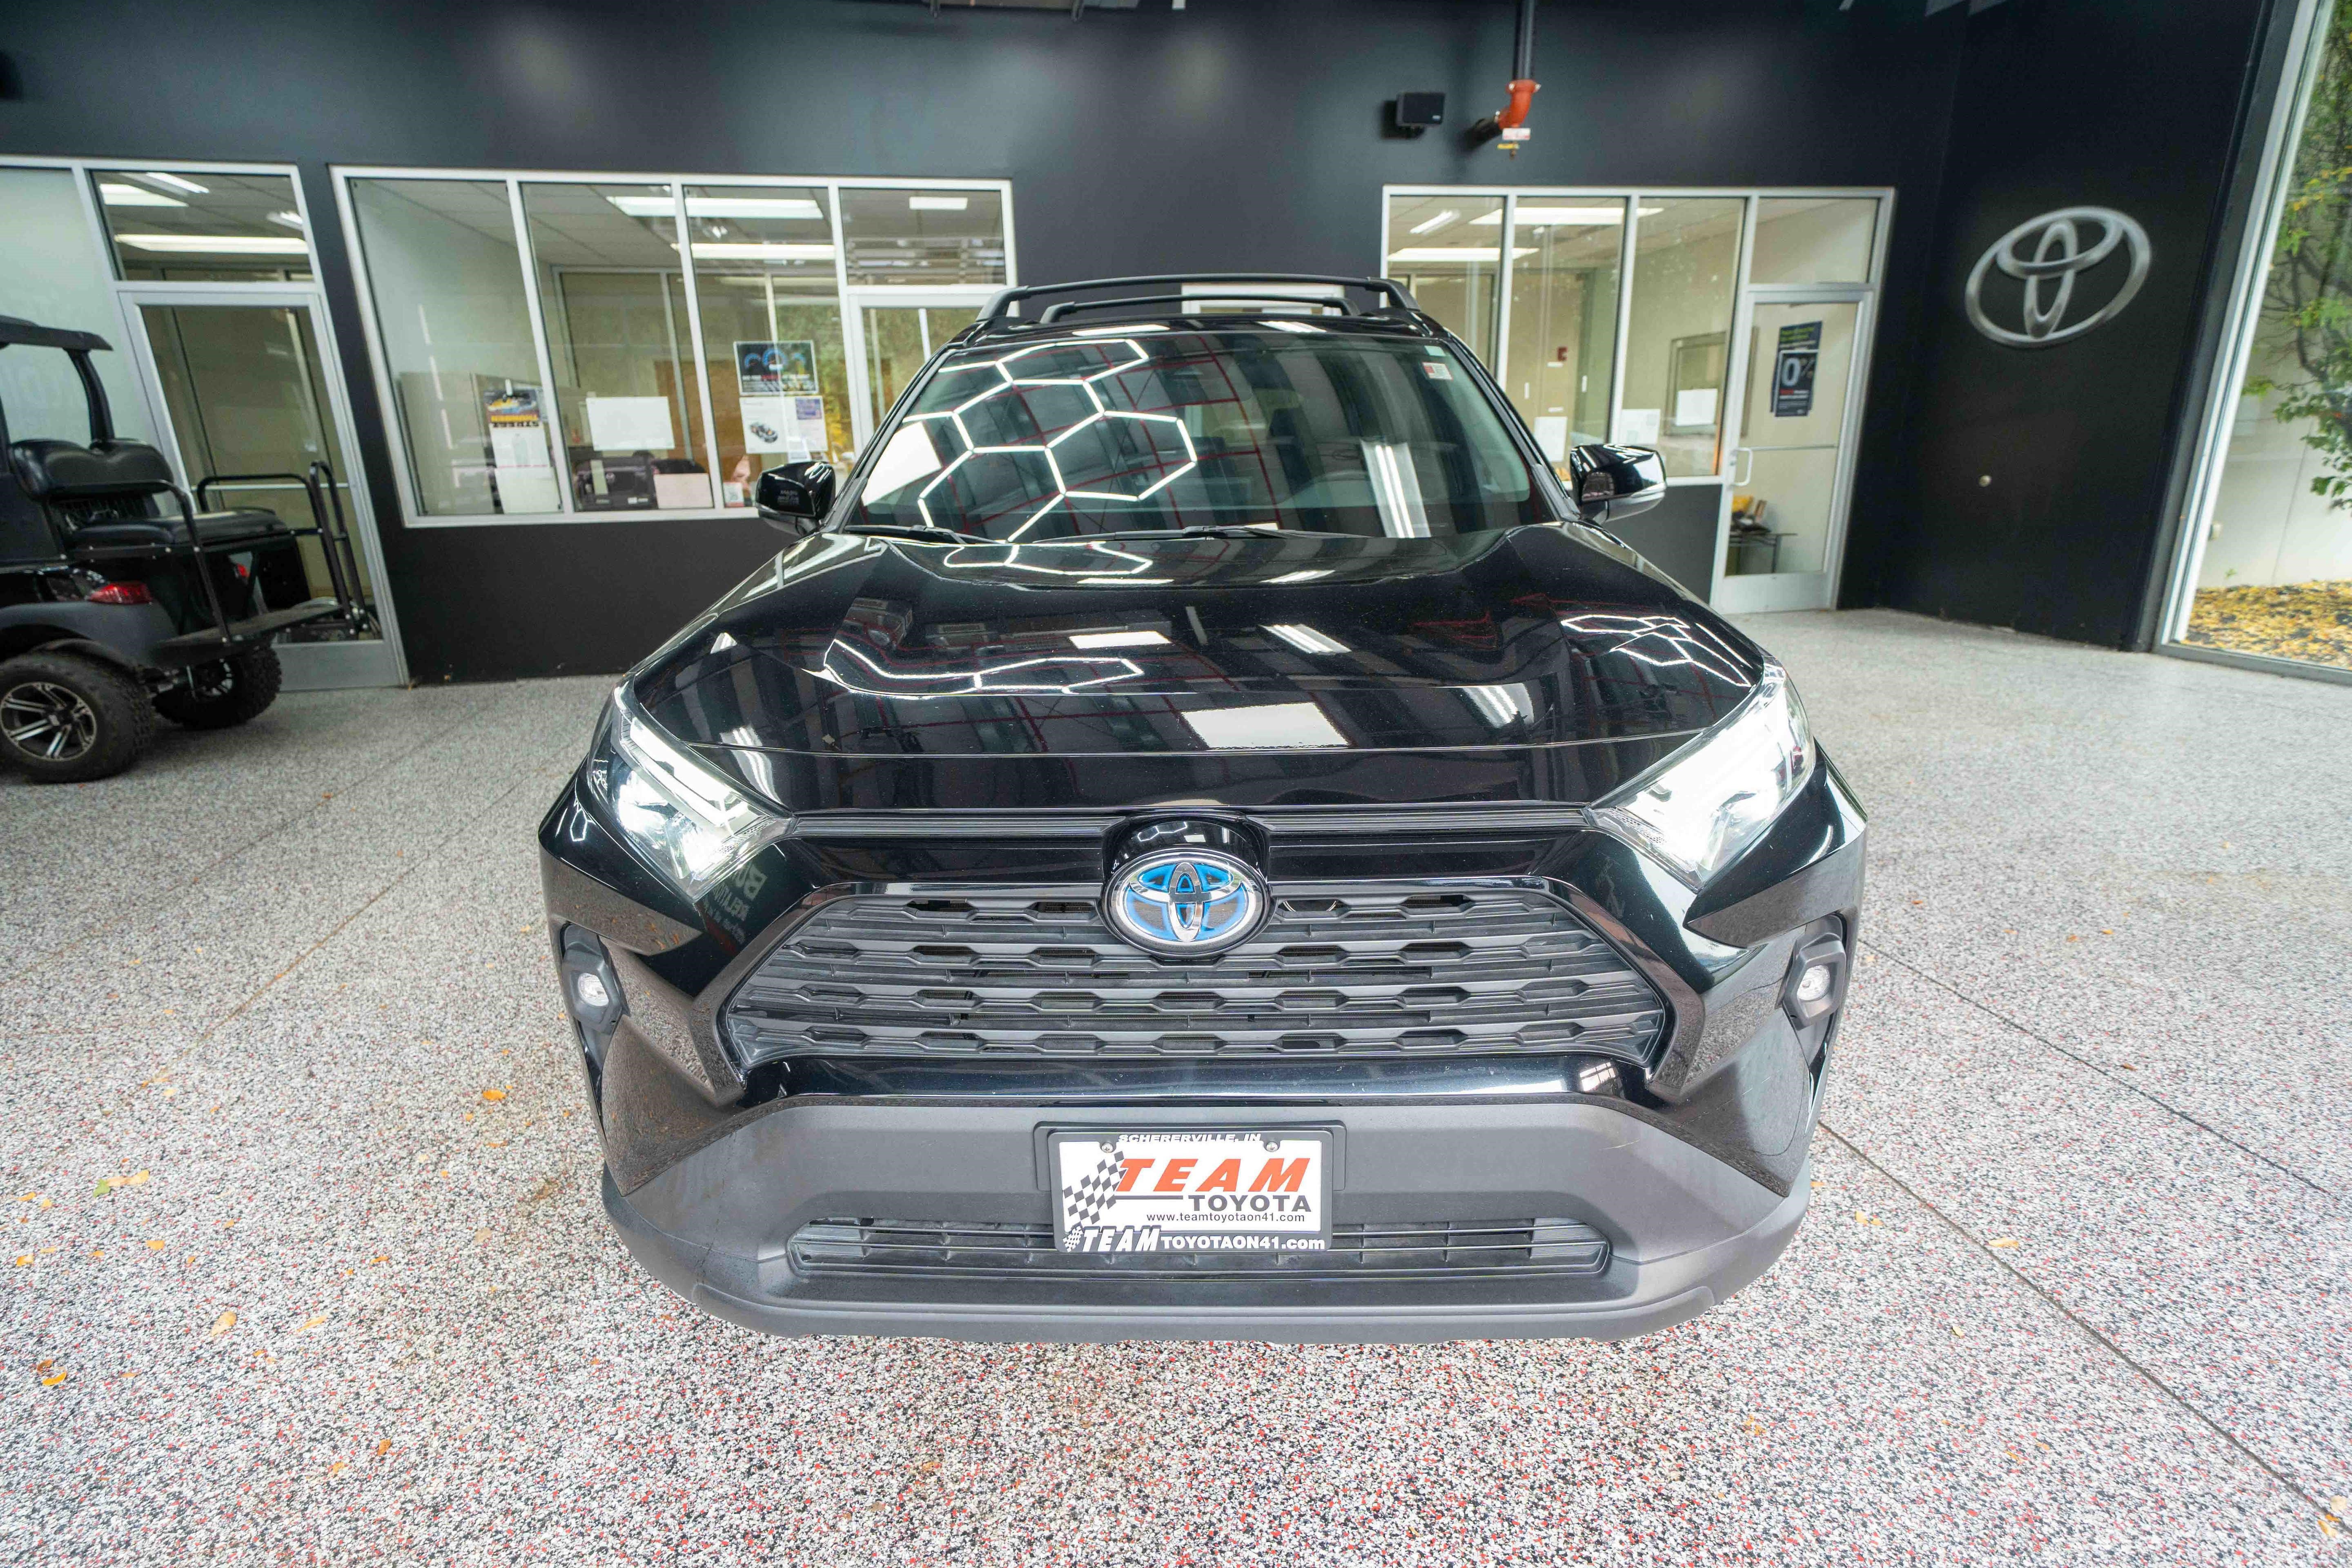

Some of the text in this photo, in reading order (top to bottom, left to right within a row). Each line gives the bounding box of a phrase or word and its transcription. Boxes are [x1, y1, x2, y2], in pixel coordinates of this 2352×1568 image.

[1243, 1133, 1261, 1142] IN
[1116, 1158, 1310, 1192] TEAM
[1188, 1195, 1312, 1212] TOYOTA
[1146, 1213, 1305, 1223] www.teamtoyotaon41.com
